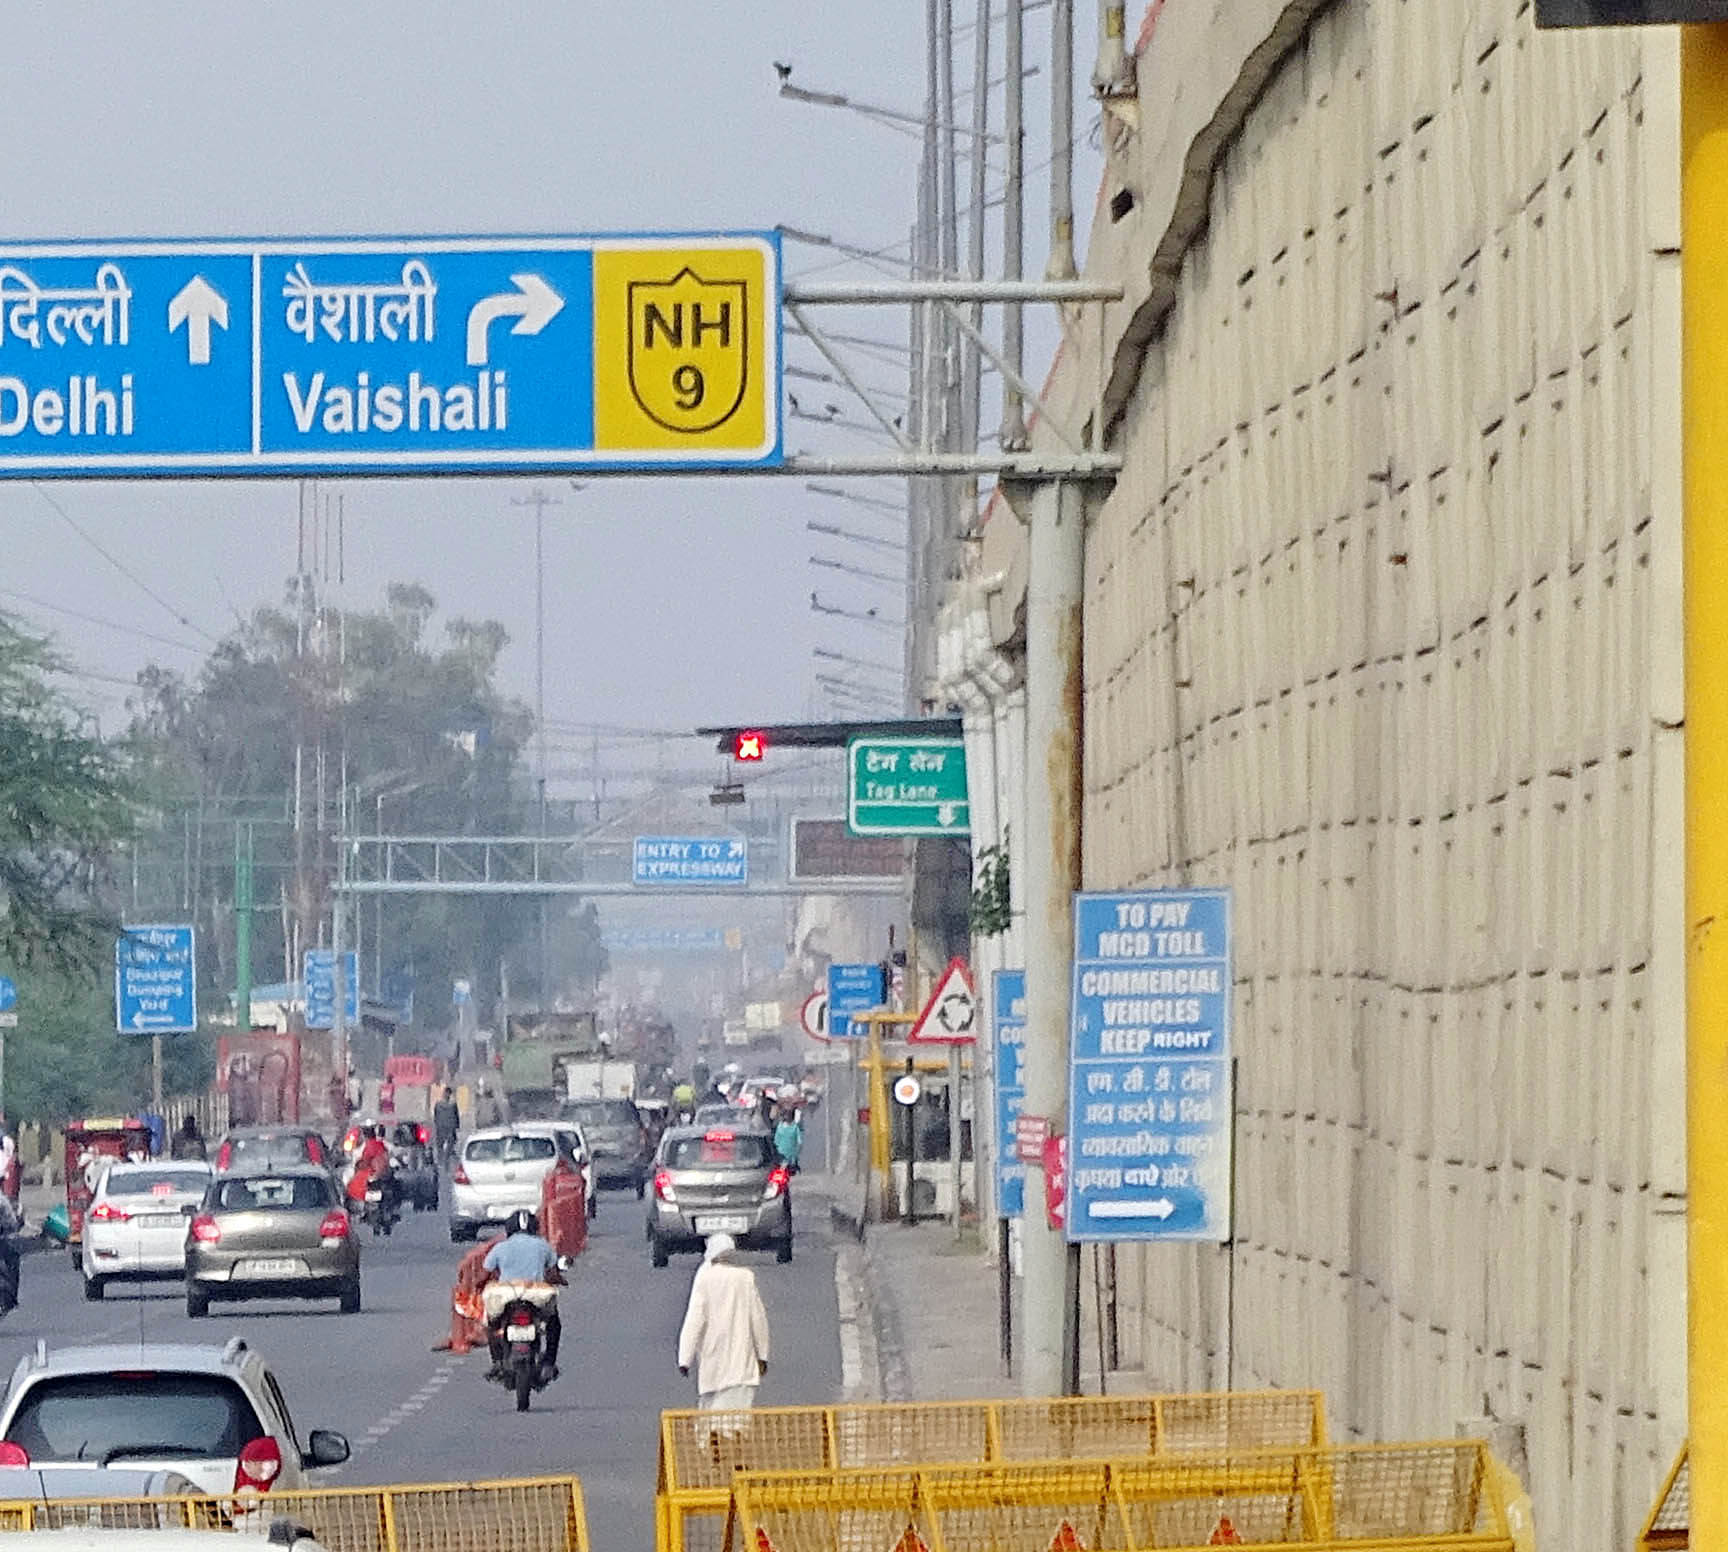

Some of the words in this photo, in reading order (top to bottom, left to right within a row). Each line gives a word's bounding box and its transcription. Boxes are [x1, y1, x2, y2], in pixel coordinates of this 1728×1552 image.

[284, 259, 438, 345] वैशाली
[644, 299, 733, 352] NH
[283, 364, 508, 434] Vaishali
[671, 365, 704, 412] 9
[637, 843, 689, 858] ENTRY
[700, 843, 721, 858] TO
[637, 861, 742, 876] EXPRESSWAY
[1115, 903, 1145, 929] TO
[1149, 902, 1192, 927] PAY
[1098, 932, 1150, 957] MCD
[1153, 931, 1206, 956] TOLL
[1082, 968, 1221, 996] COMMERCIAL
[1102, 998, 1201, 1026] VEHICLES
[1100, 1029, 1151, 1055] KEEP
[1153, 1030, 1212, 1049] RIGHT
